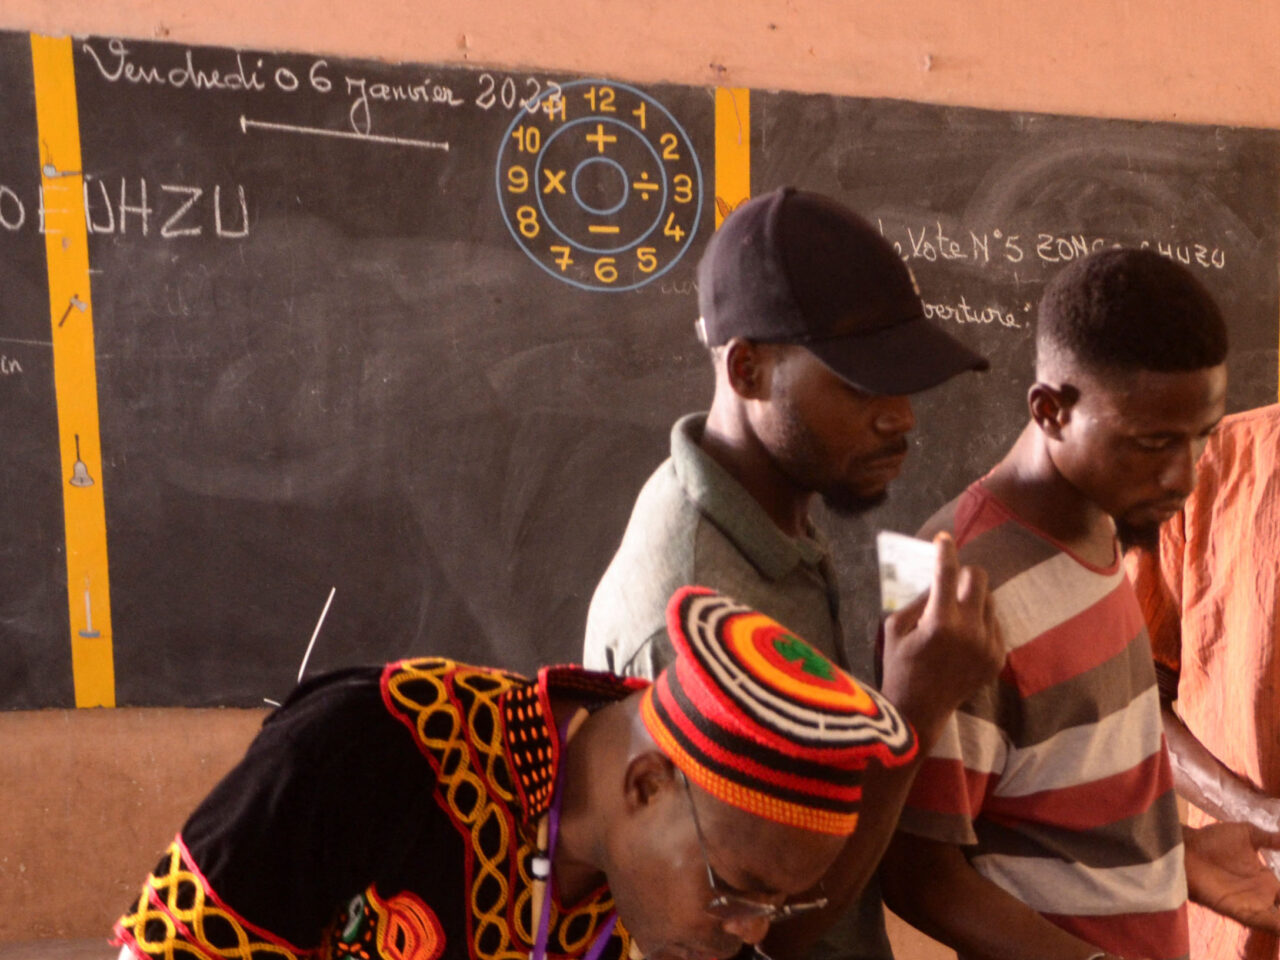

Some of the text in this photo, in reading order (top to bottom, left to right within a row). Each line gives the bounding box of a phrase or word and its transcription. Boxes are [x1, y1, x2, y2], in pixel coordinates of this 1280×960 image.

[83, 39, 265, 90] Vendredi
[475, 73, 563, 115] 2023
[584, 86, 617, 113] 12
[632, 101, 647, 129] 1
[511, 125, 541, 154] 10
[660, 133, 680, 160] 2
[507, 165, 529, 194] 9
[673, 174, 692, 204] 3
[516, 205, 540, 238] 8
[663, 212, 685, 242] 4
[906, 221, 968, 262] Vote
[550, 245, 574, 271] 7
[594, 257, 618, 283] 6
[637, 246, 658, 272] 5
